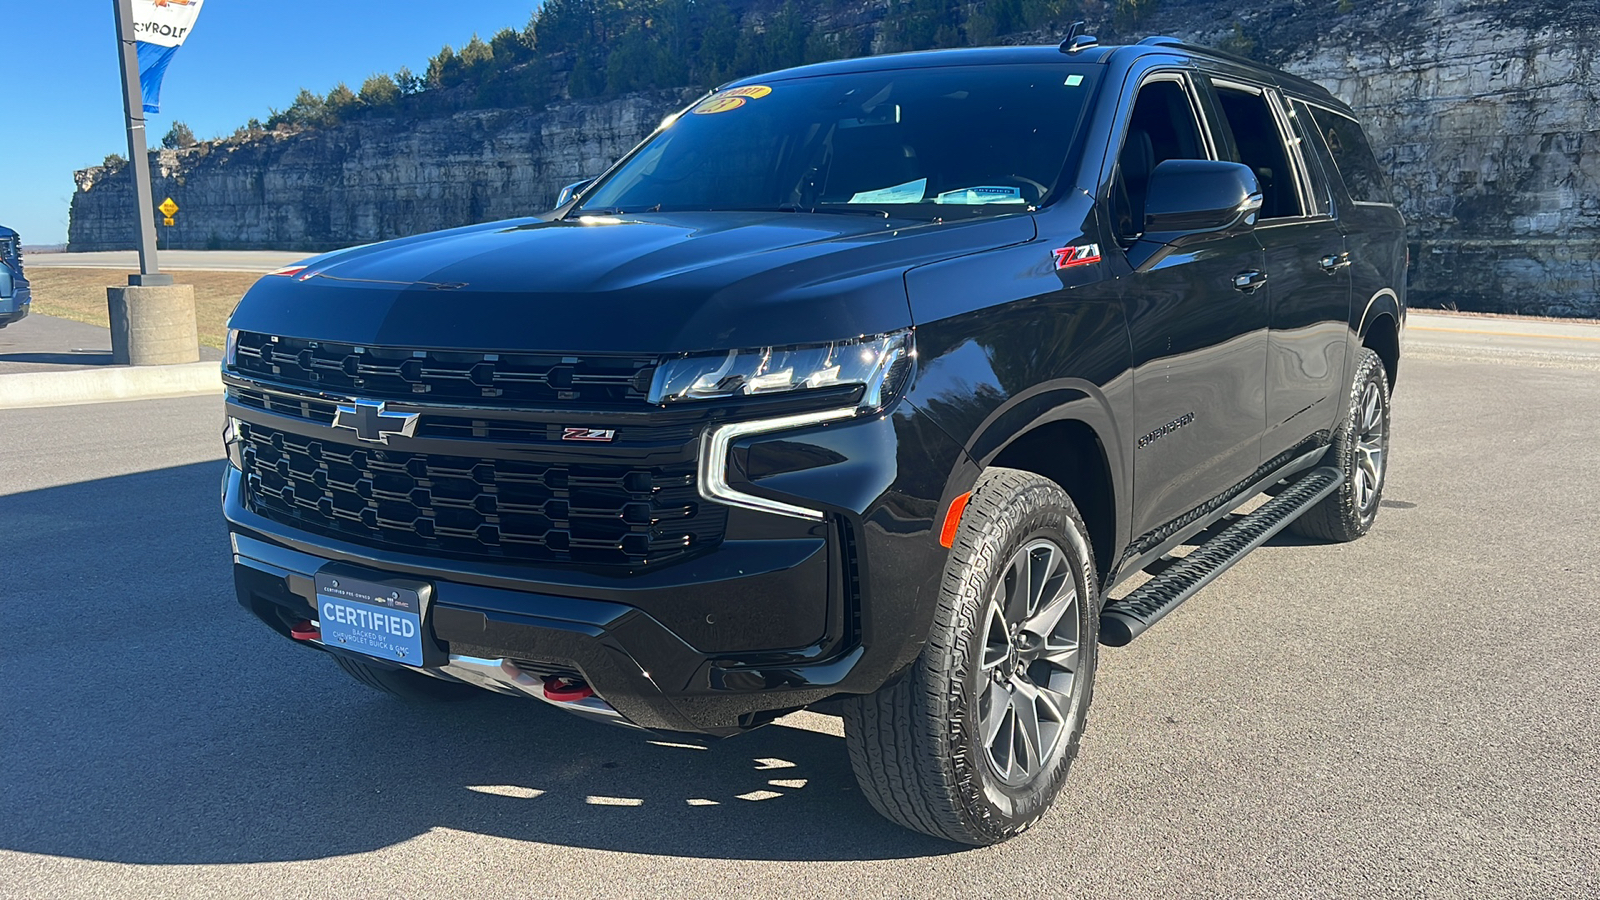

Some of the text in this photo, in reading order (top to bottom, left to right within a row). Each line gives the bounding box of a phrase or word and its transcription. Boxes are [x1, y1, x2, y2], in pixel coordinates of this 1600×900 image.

[1051, 243, 1102, 270] Z71
[562, 427, 616, 441] Z71
[1138, 411, 1195, 449] SUBURBAN
[323, 586, 345, 595] CERTIFIED
[323, 602, 415, 638] CERTIFIED
[332, 631, 367, 644] CHEVROLET
[369, 640, 388, 649] BUICK
[395, 645, 410, 654] GMC
[352, 629, 387, 643] BACKED BY
